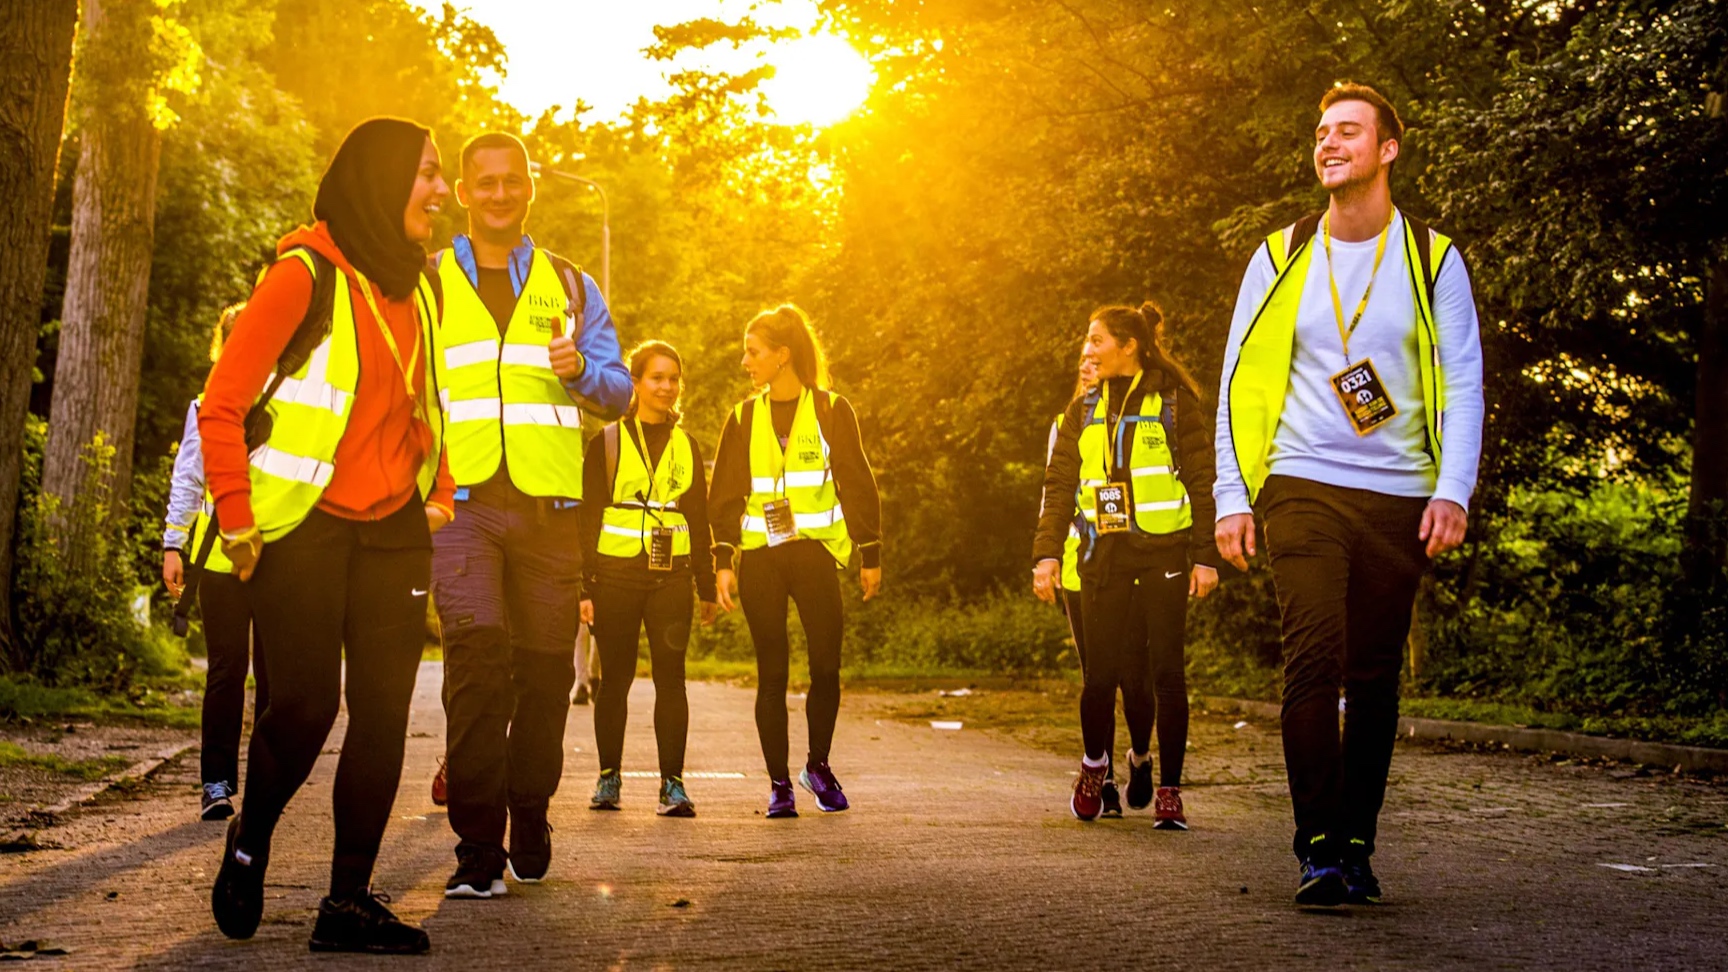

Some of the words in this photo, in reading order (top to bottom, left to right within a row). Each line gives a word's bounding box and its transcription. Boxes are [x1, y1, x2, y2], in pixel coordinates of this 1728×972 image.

[529, 294, 560, 308] BKB
[1341, 369, 1373, 393] 0321
[1099, 490, 1121, 501] 1085
